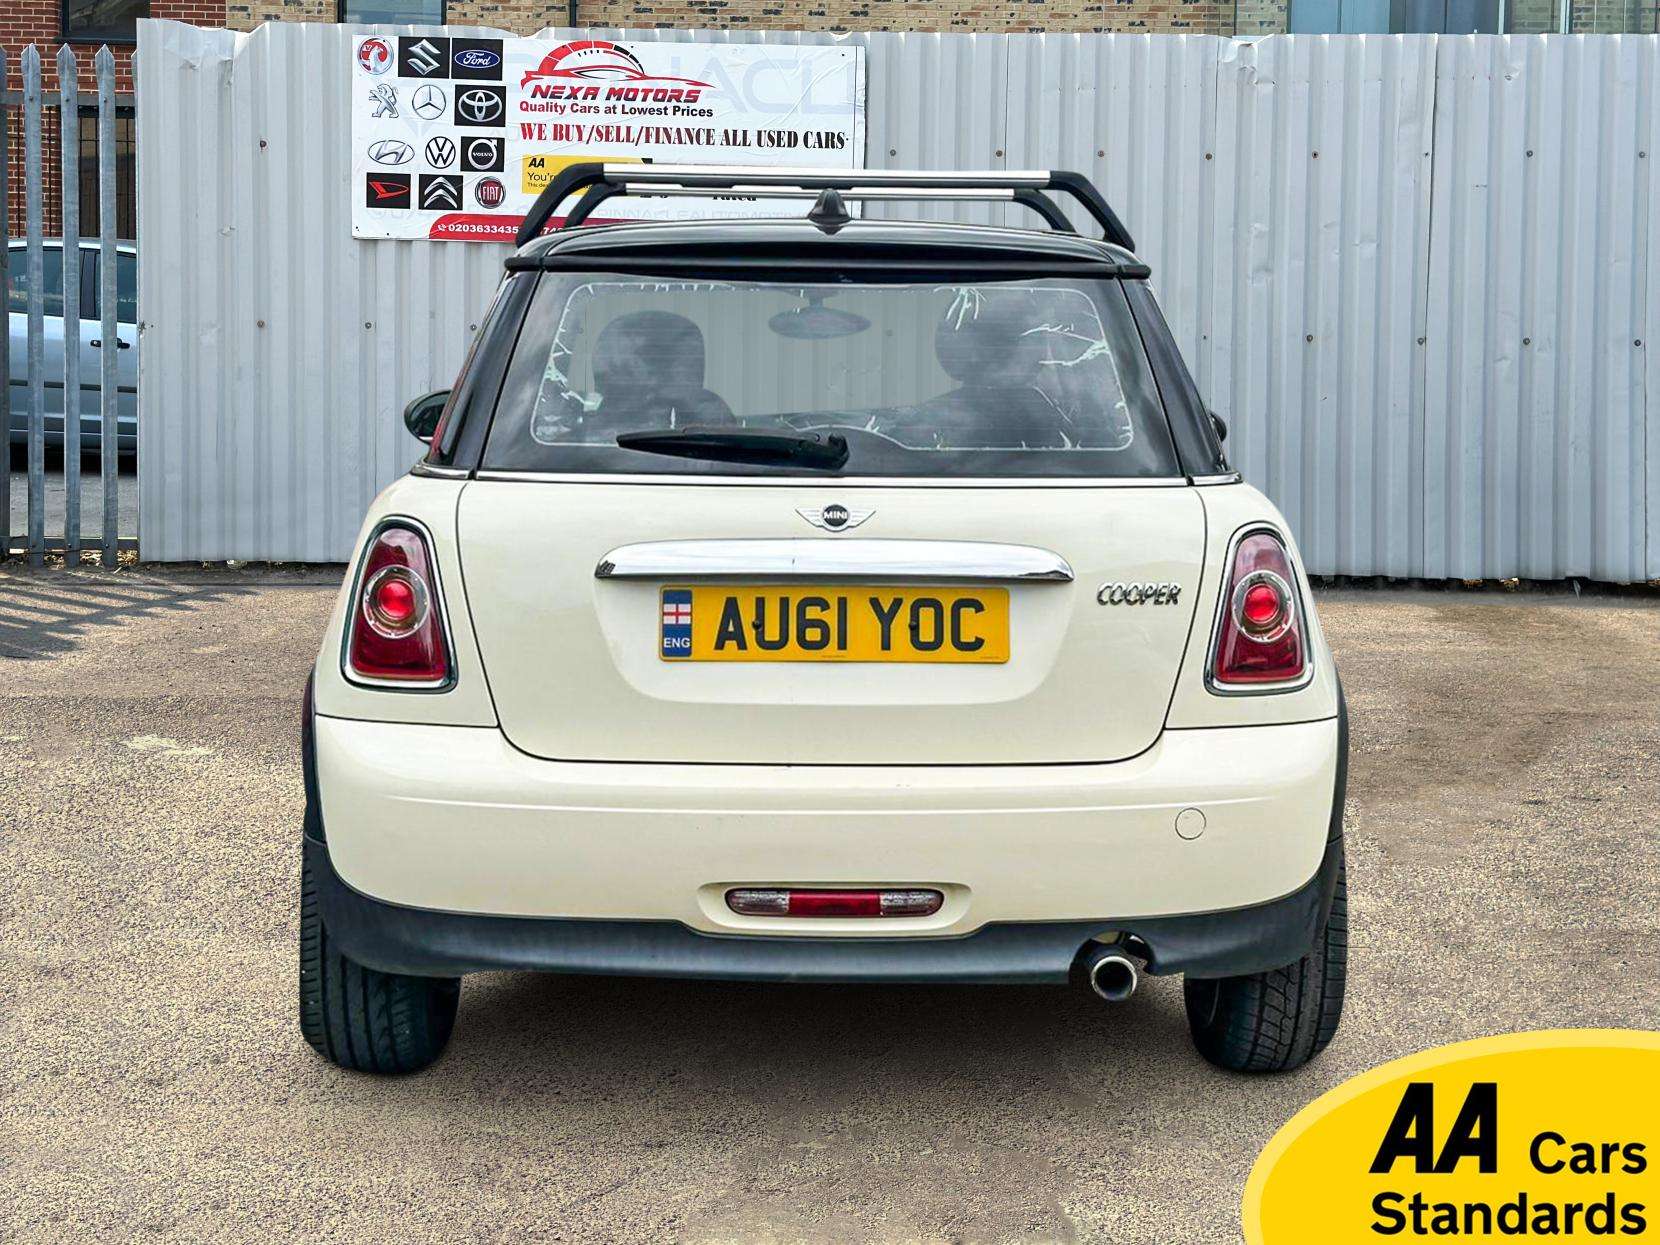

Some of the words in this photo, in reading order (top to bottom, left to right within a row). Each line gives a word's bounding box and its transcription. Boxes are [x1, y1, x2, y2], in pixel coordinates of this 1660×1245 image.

[462, 51, 491, 66] Ford
[530, 84, 600, 100] NEXA
[605, 87, 702, 104] MOTORS
[519, 101, 567, 115] Quality
[570, 102, 600, 115] Cars
[604, 104, 617, 115] at
[621, 104, 668, 117] Lowest
[672, 105, 714, 118] Prices
[520, 123, 547, 141] WE
[720, 128, 751, 147] ALL
[756, 130, 799, 148] USED
[803, 131, 846, 150] CARS
[528, 157, 545, 168] AA
[527, 172, 557, 182] You'r
[482, 186, 500, 201] FIAT
[448, 223, 520, 234] 0203633435
[823, 511, 848, 520] MINI
[1096, 582, 1182, 606] COOPER
[713, 596, 848, 651] AU61
[868, 596, 986, 652] YOC
[663, 638, 690, 648] ENG
